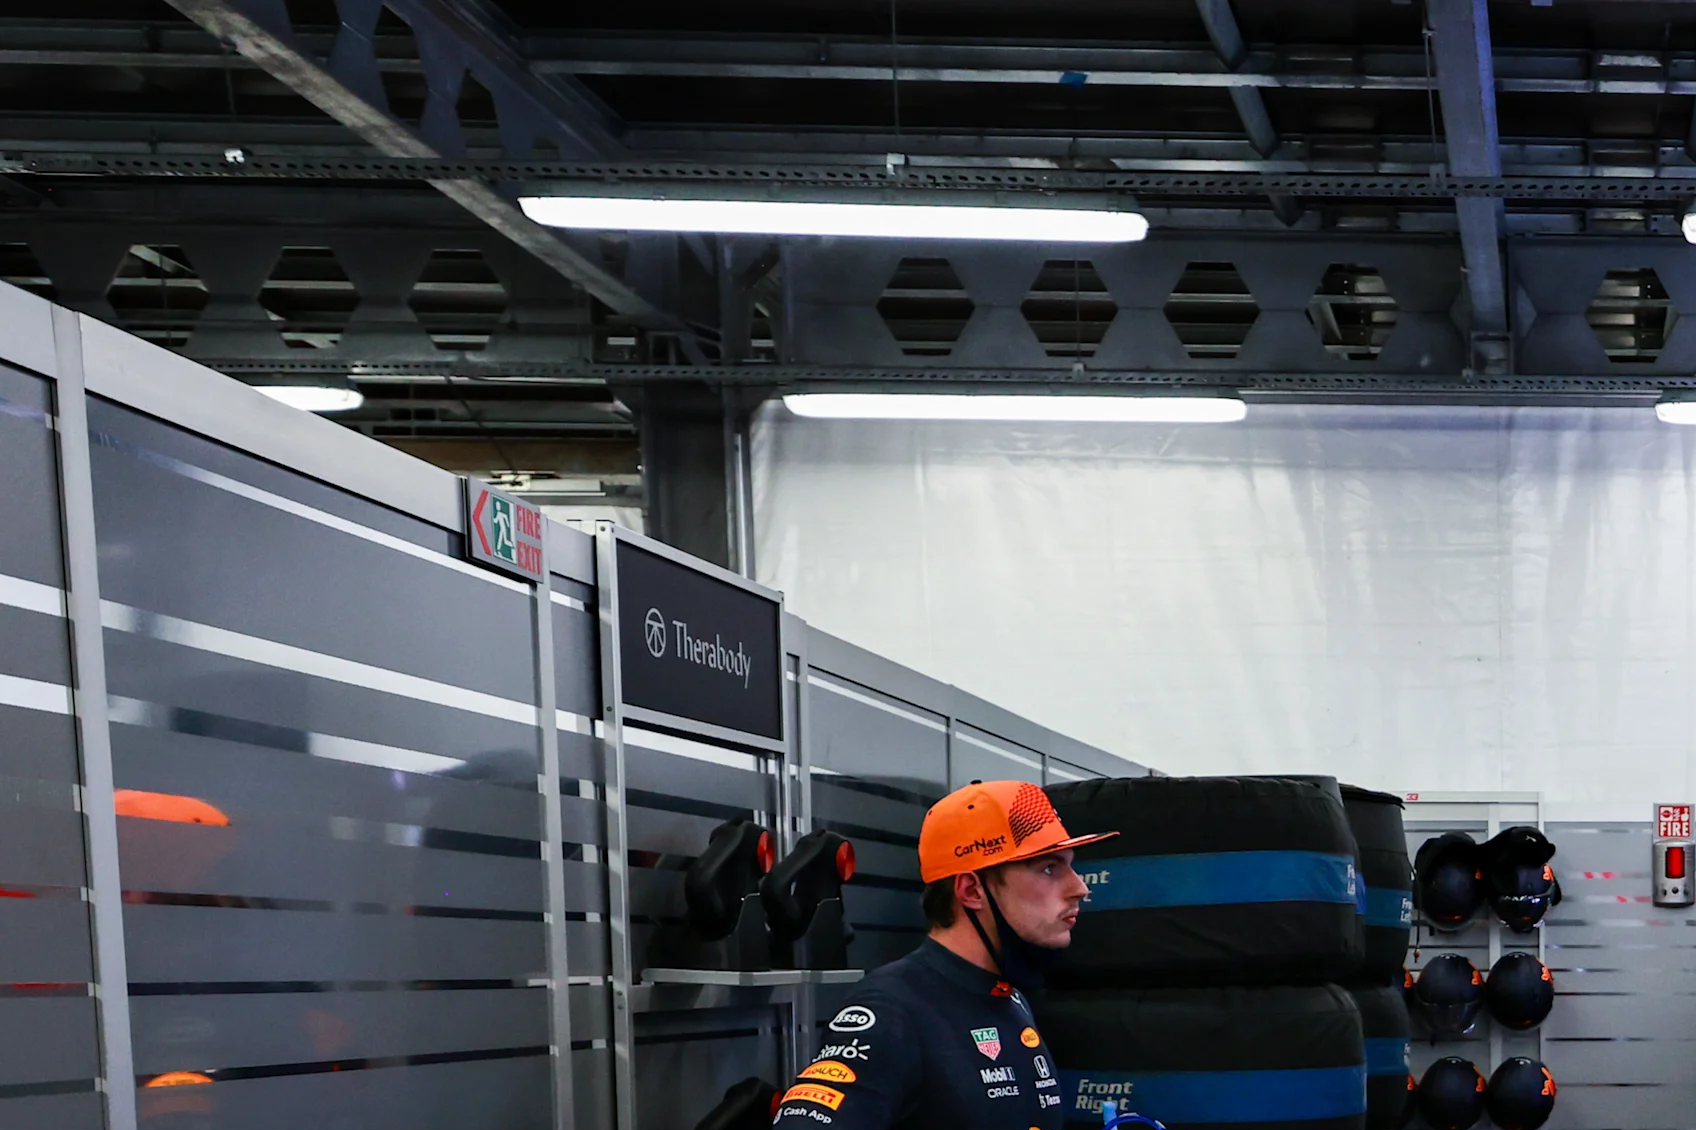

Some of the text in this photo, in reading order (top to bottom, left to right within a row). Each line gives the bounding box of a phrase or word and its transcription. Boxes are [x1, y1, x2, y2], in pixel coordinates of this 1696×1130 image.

[516, 504, 542, 540] FIRE
[517, 540, 543, 576] EXIT
[672, 619, 752, 689] Therabody
[1659, 821, 1690, 837] FIRE
[954, 835, 1007, 858] CarNext
[974, 1031, 997, 1042] TAG
[987, 1085, 1020, 1099] ORACLE
[1035, 1078, 1057, 1089] HONDA
[1078, 1079, 1133, 1094] Front
[783, 1106, 833, 1124] Cash App
